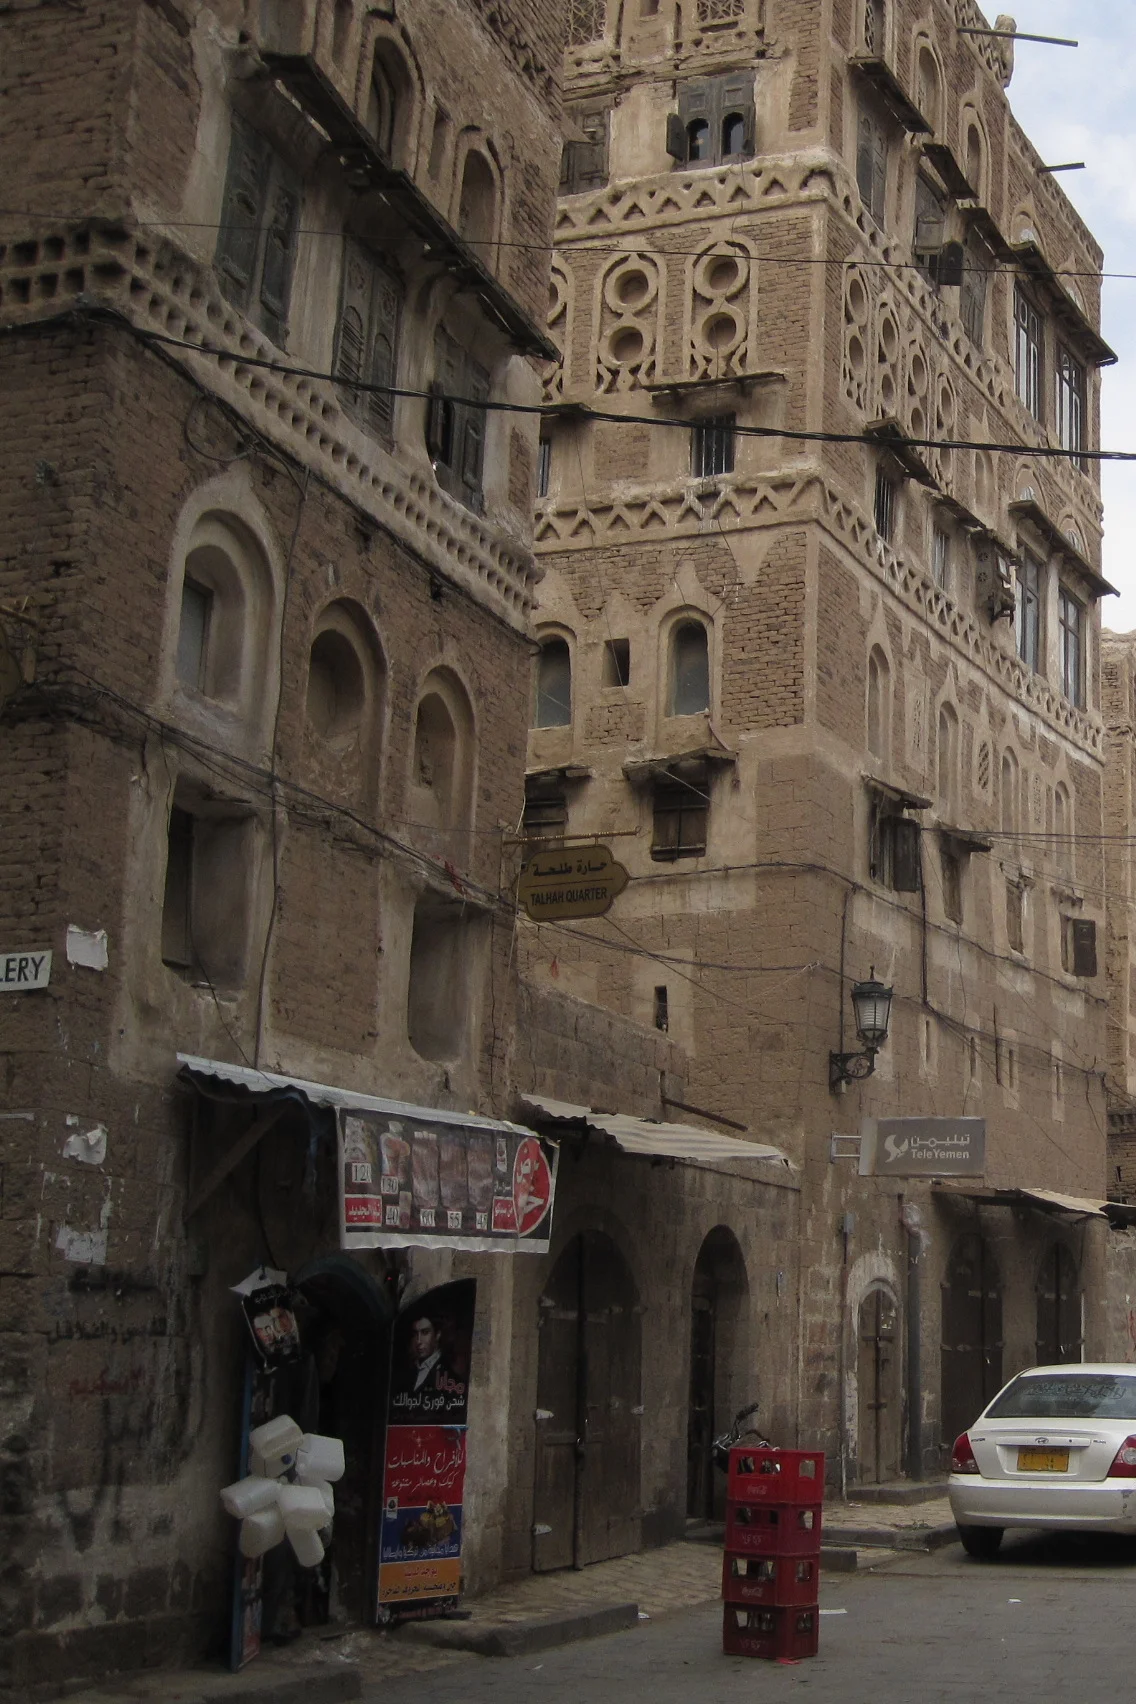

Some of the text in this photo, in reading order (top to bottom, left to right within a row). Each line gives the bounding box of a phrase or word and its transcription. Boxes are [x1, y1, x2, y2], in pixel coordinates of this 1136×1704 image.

[530, 886, 608, 907] TALHAH QUARTER
[0, 956, 46, 982] ERY
[910, 1148, 970, 1160] TeleYemen
